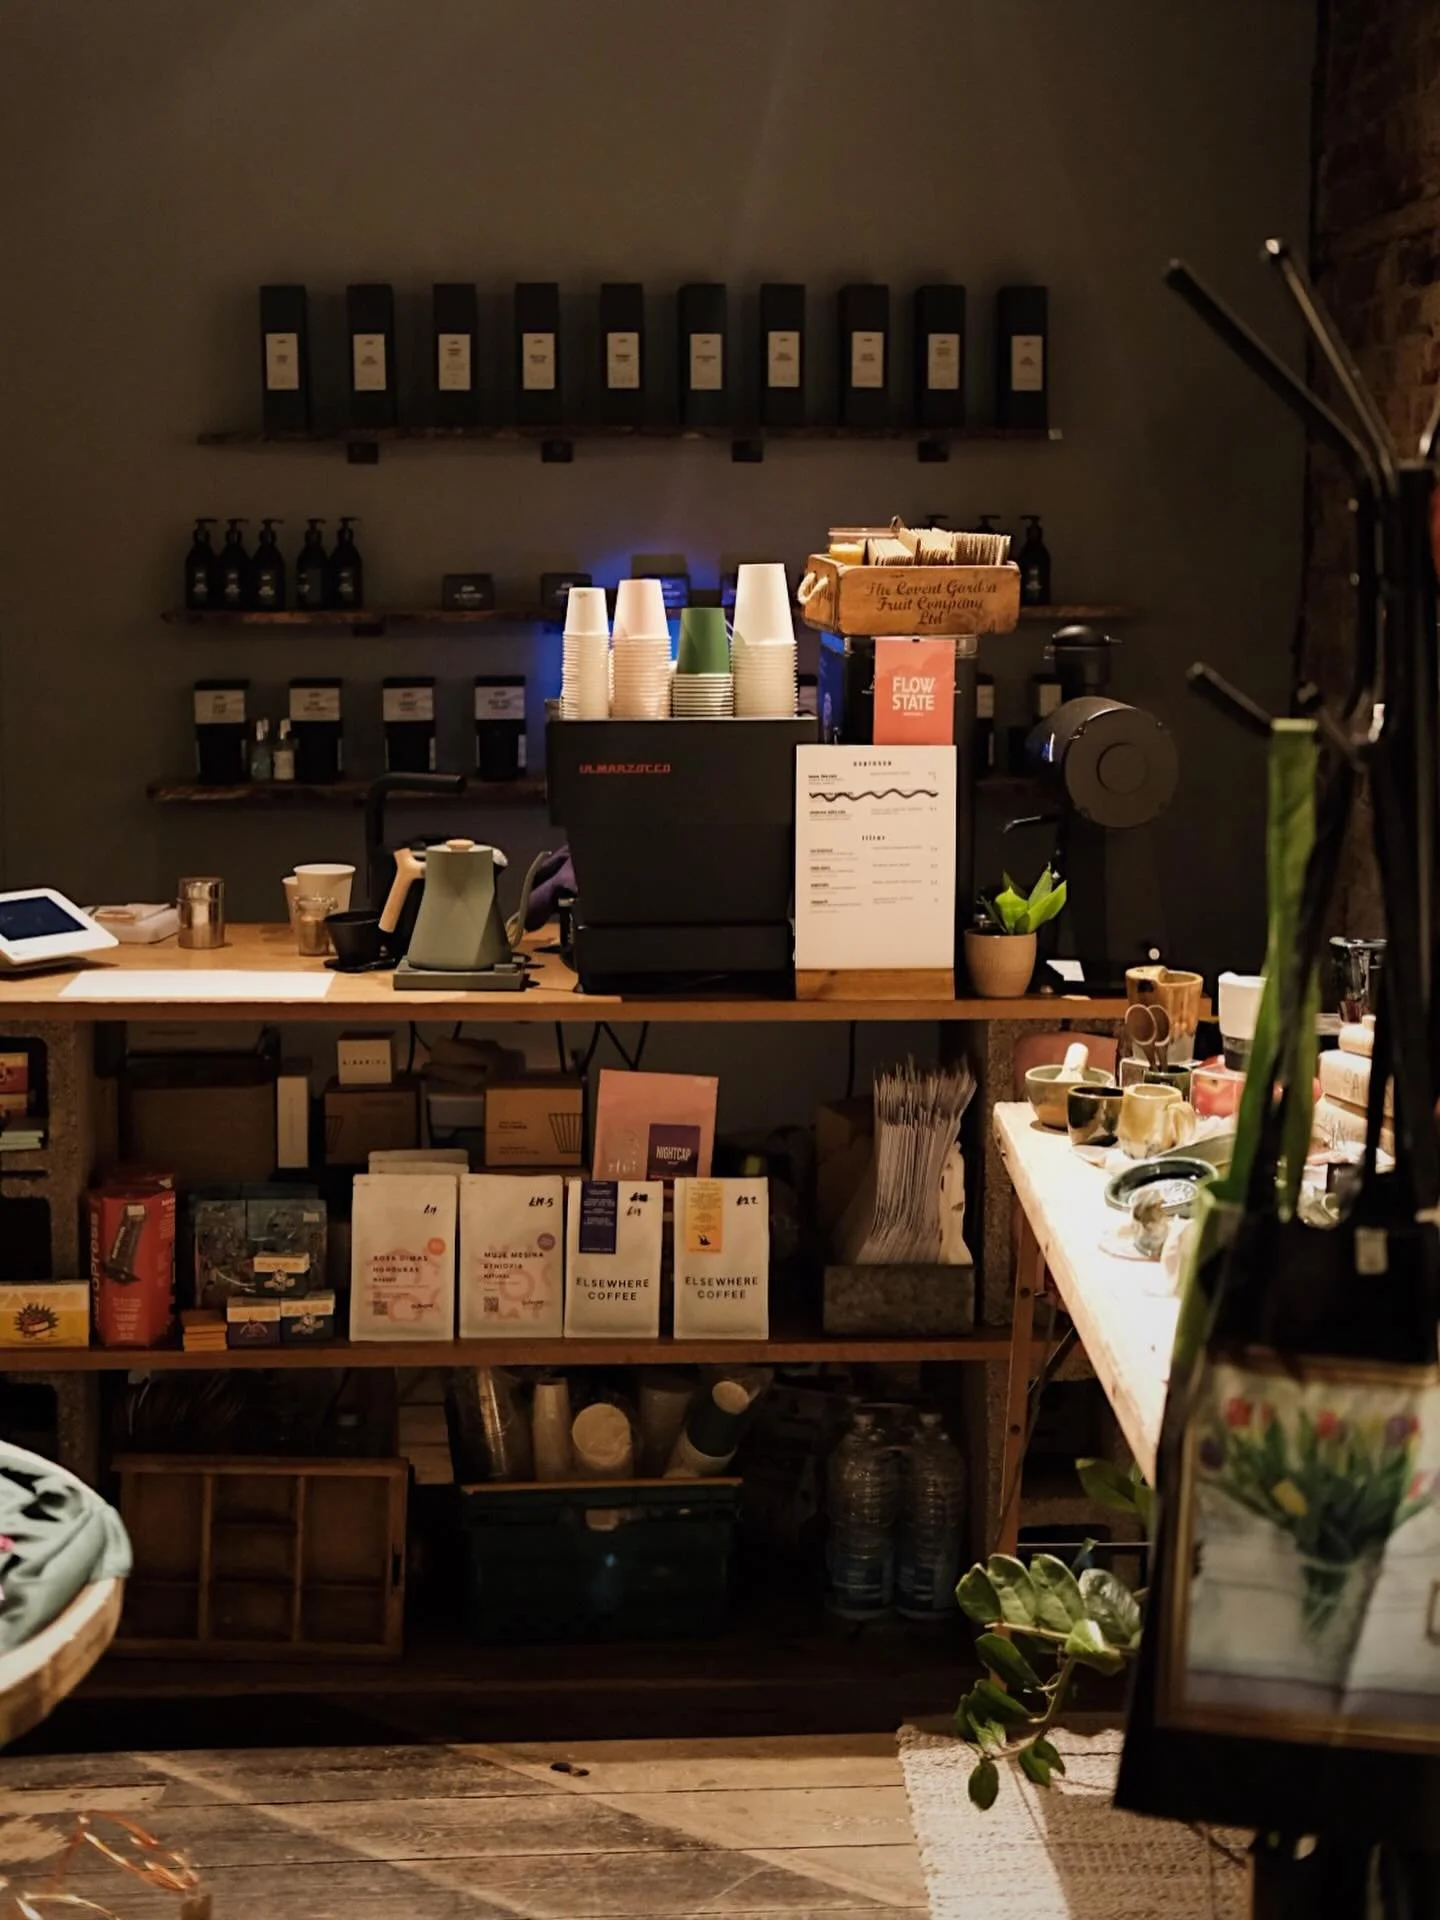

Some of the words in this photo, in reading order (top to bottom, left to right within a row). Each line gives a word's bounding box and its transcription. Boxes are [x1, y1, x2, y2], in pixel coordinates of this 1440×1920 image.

[866, 581, 891, 596] The
[895, 580, 941, 595] Covent
[876, 596, 913, 611] Fruit
[917, 597, 985, 614] Company
[917, 611, 944, 625] Ltd
[892, 676, 936, 692] FLOW
[892, 694, 935, 711] STATE
[656, 1145, 692, 1161] NIGHTCAP
[576, 1277, 650, 1289] ELSEWHERE
[684, 1275, 759, 1287] ELSEWHERE
[588, 1291, 638, 1301] COFFEE
[697, 1289, 746, 1299] COFFEE
